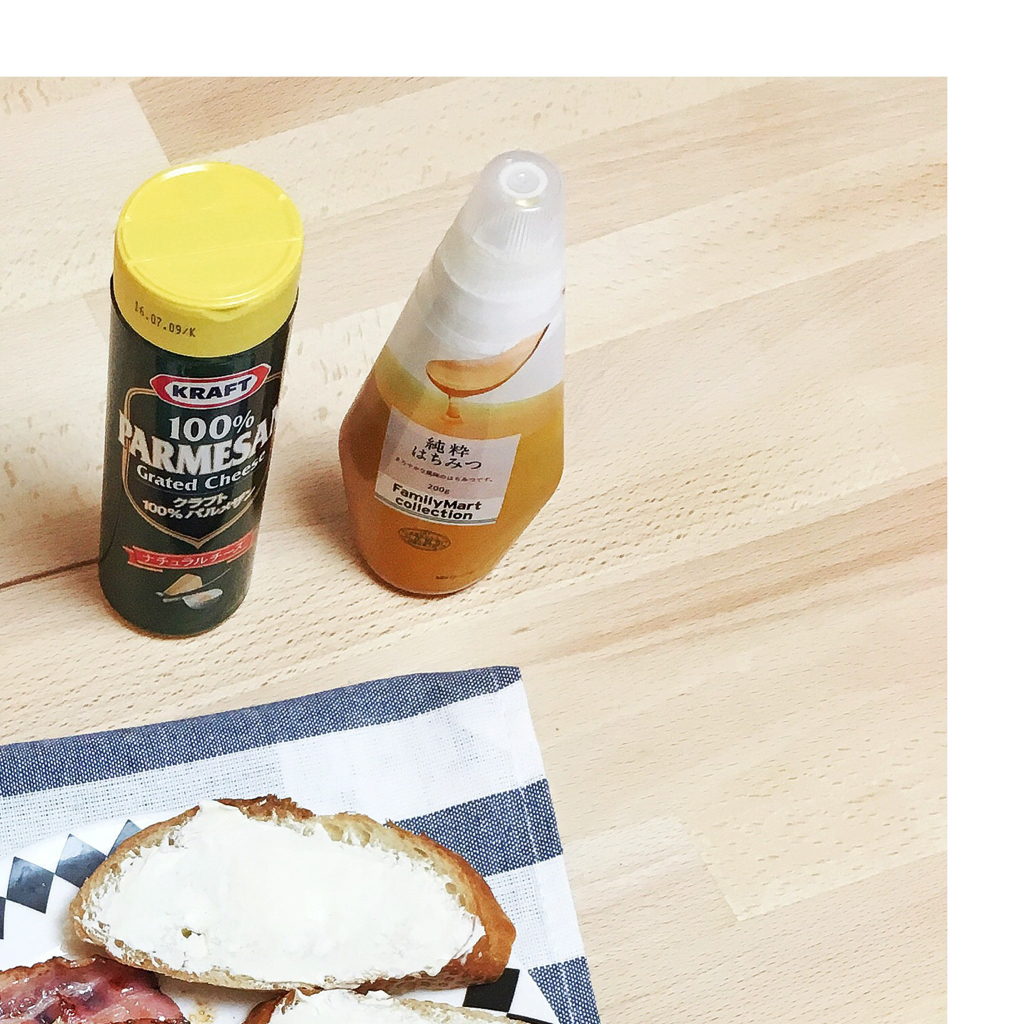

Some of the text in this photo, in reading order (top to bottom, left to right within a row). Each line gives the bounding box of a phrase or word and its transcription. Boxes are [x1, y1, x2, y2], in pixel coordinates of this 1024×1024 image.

[134, 300, 196, 338] 16.07.09/K
[171, 374, 253, 401] KRAFT
[169, 409, 255, 442] 100%
[411, 445, 482, 471] はちみつ
[425, 436, 470, 458] 純粋
[136, 451, 266, 492] Grated Cheese
[173, 492, 228, 509] クラフト
[392, 482, 482, 511] FamilyMart
[427, 483, 451, 495] 200g
[142, 486, 256, 520] 100% パルメザン
[395, 496, 473, 521] collection
[143, 541, 244, 566] ナチュラルチーズ
